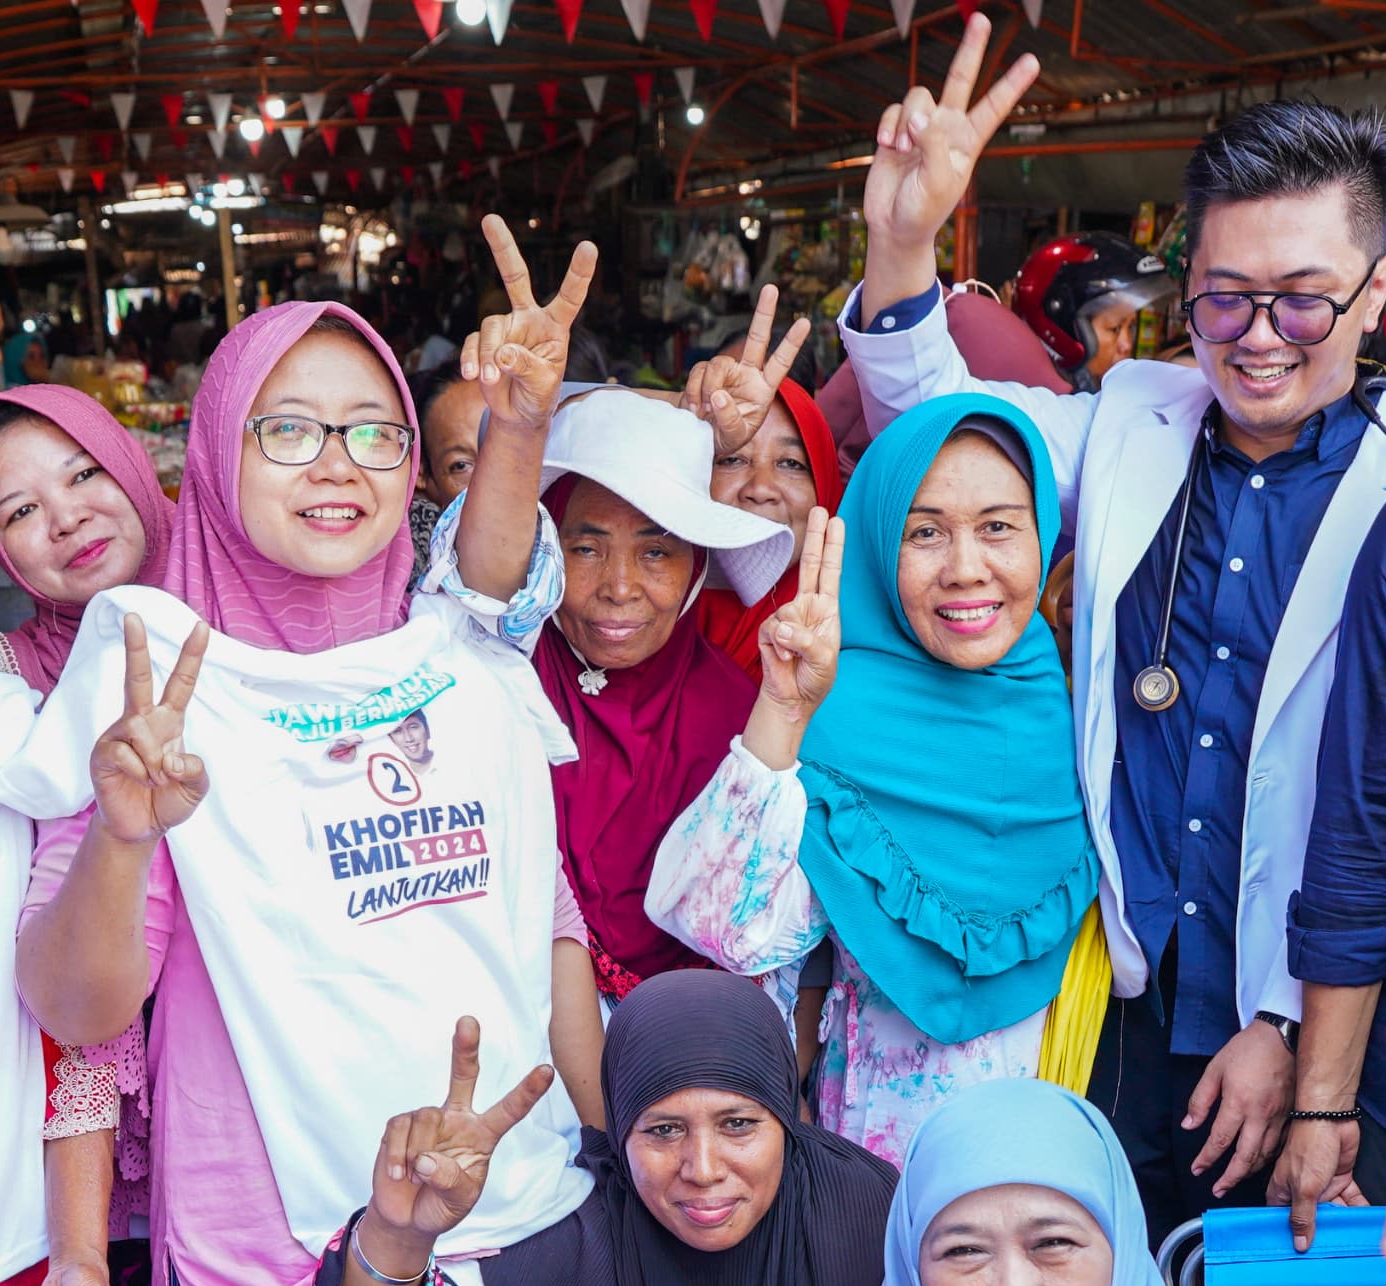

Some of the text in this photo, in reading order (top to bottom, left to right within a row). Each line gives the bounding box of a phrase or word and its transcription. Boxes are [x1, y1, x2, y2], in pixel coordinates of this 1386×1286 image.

[382, 762, 411, 793] 2
[323, 800, 485, 851] KHOFIFAH
[329, 833, 481, 881] EMIL 2024
[346, 858, 491, 920] LANJUTKAN!!
